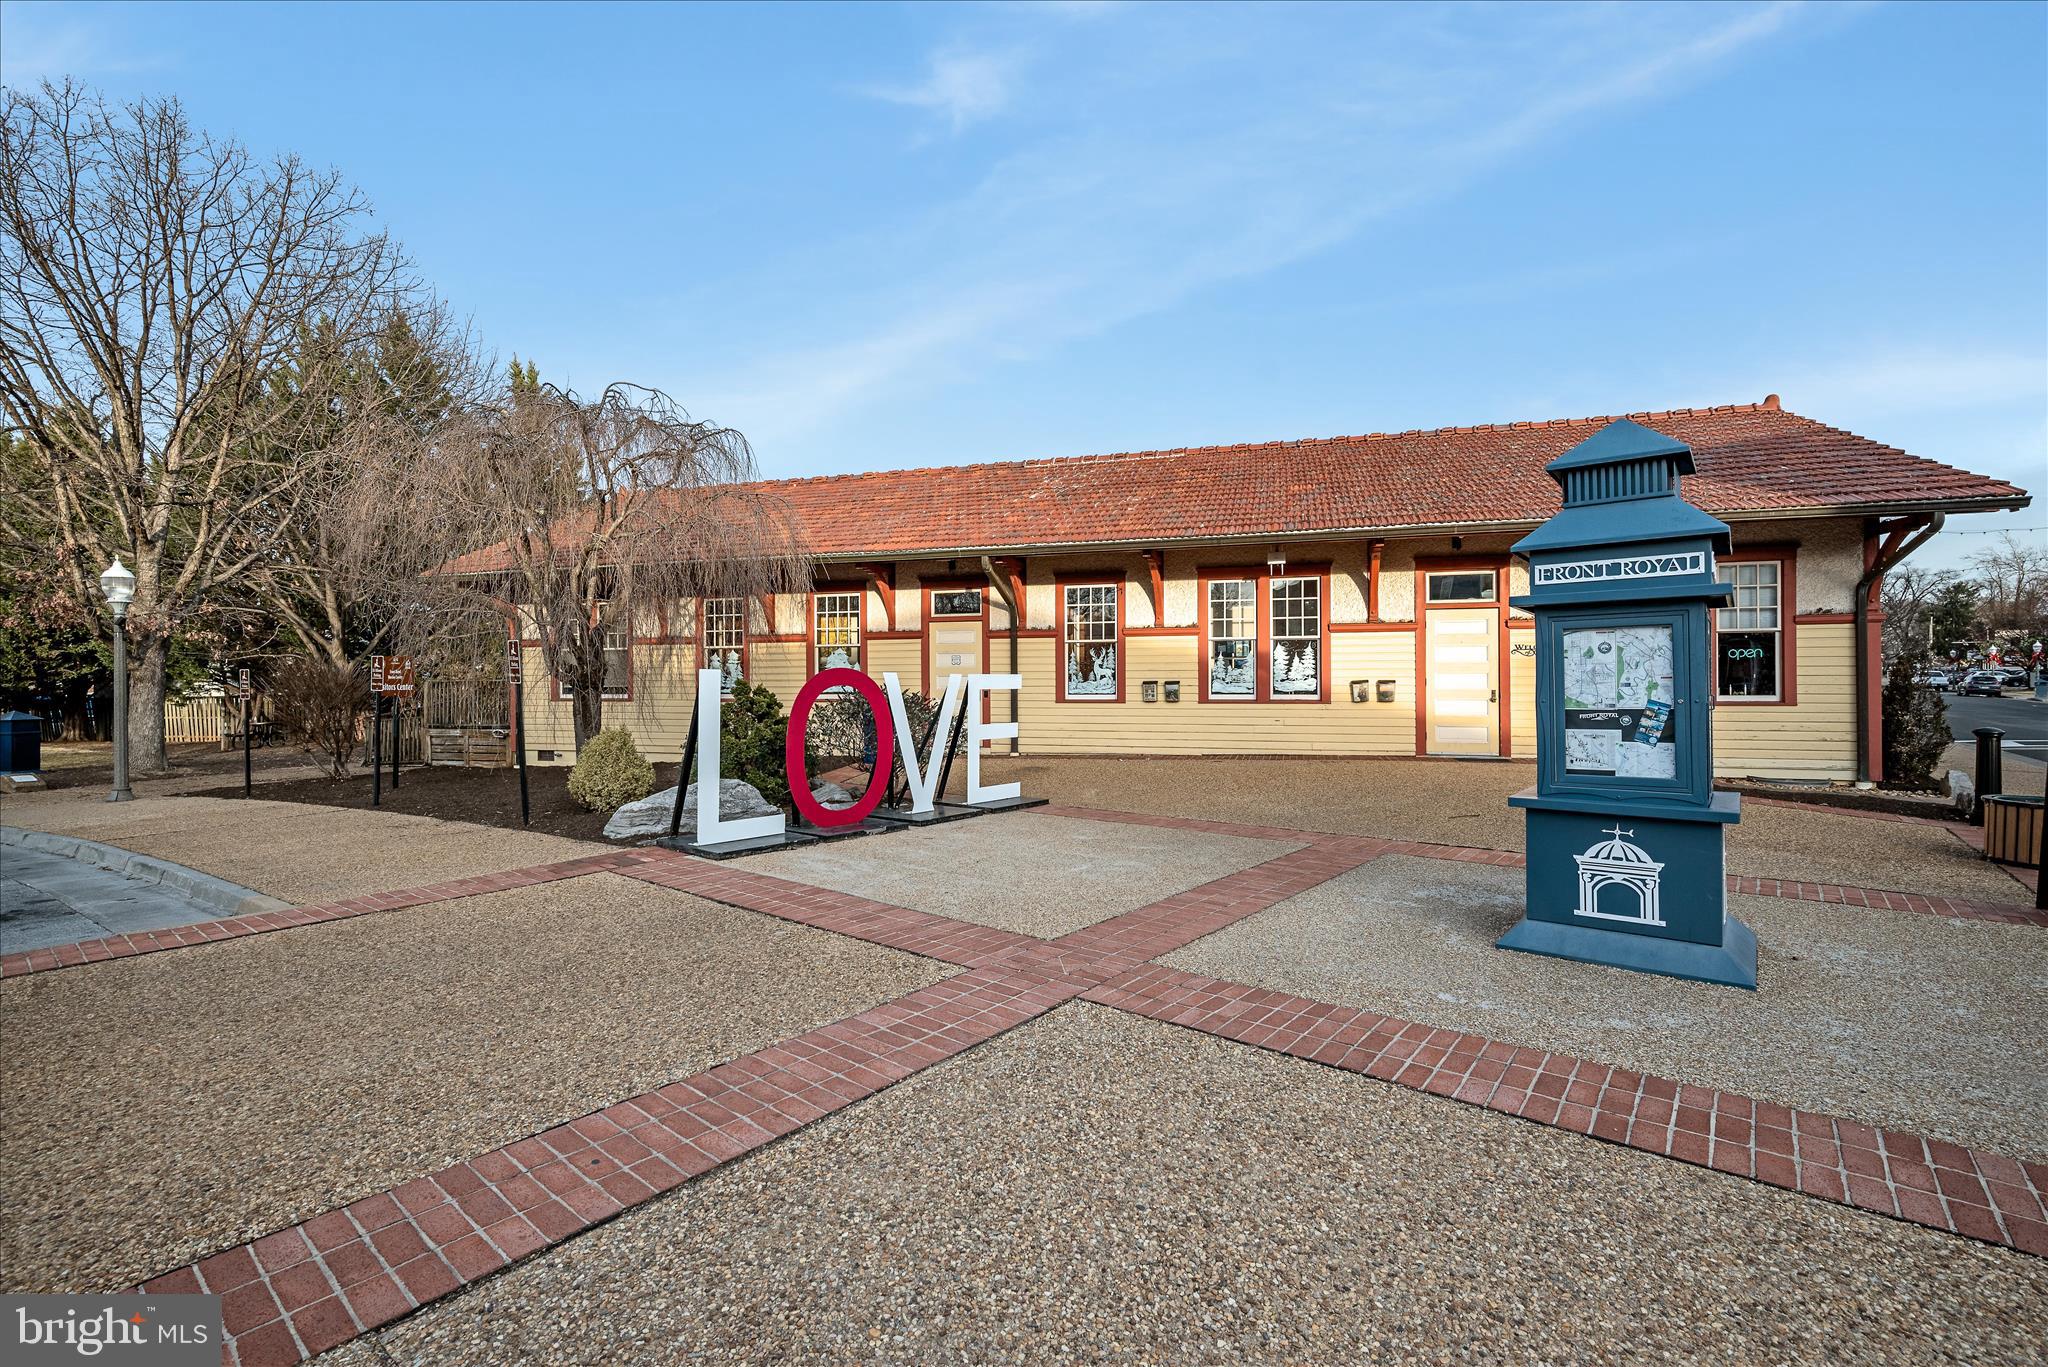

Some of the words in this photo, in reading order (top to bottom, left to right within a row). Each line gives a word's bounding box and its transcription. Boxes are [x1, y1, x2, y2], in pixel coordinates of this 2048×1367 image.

[1540, 562, 1612, 582] FRONT
[1620, 556, 1701, 576] ROYAL
[1728, 648, 1763, 661] open
[396, 683, 414, 691] Center
[697, 667, 1023, 846] LOVE
